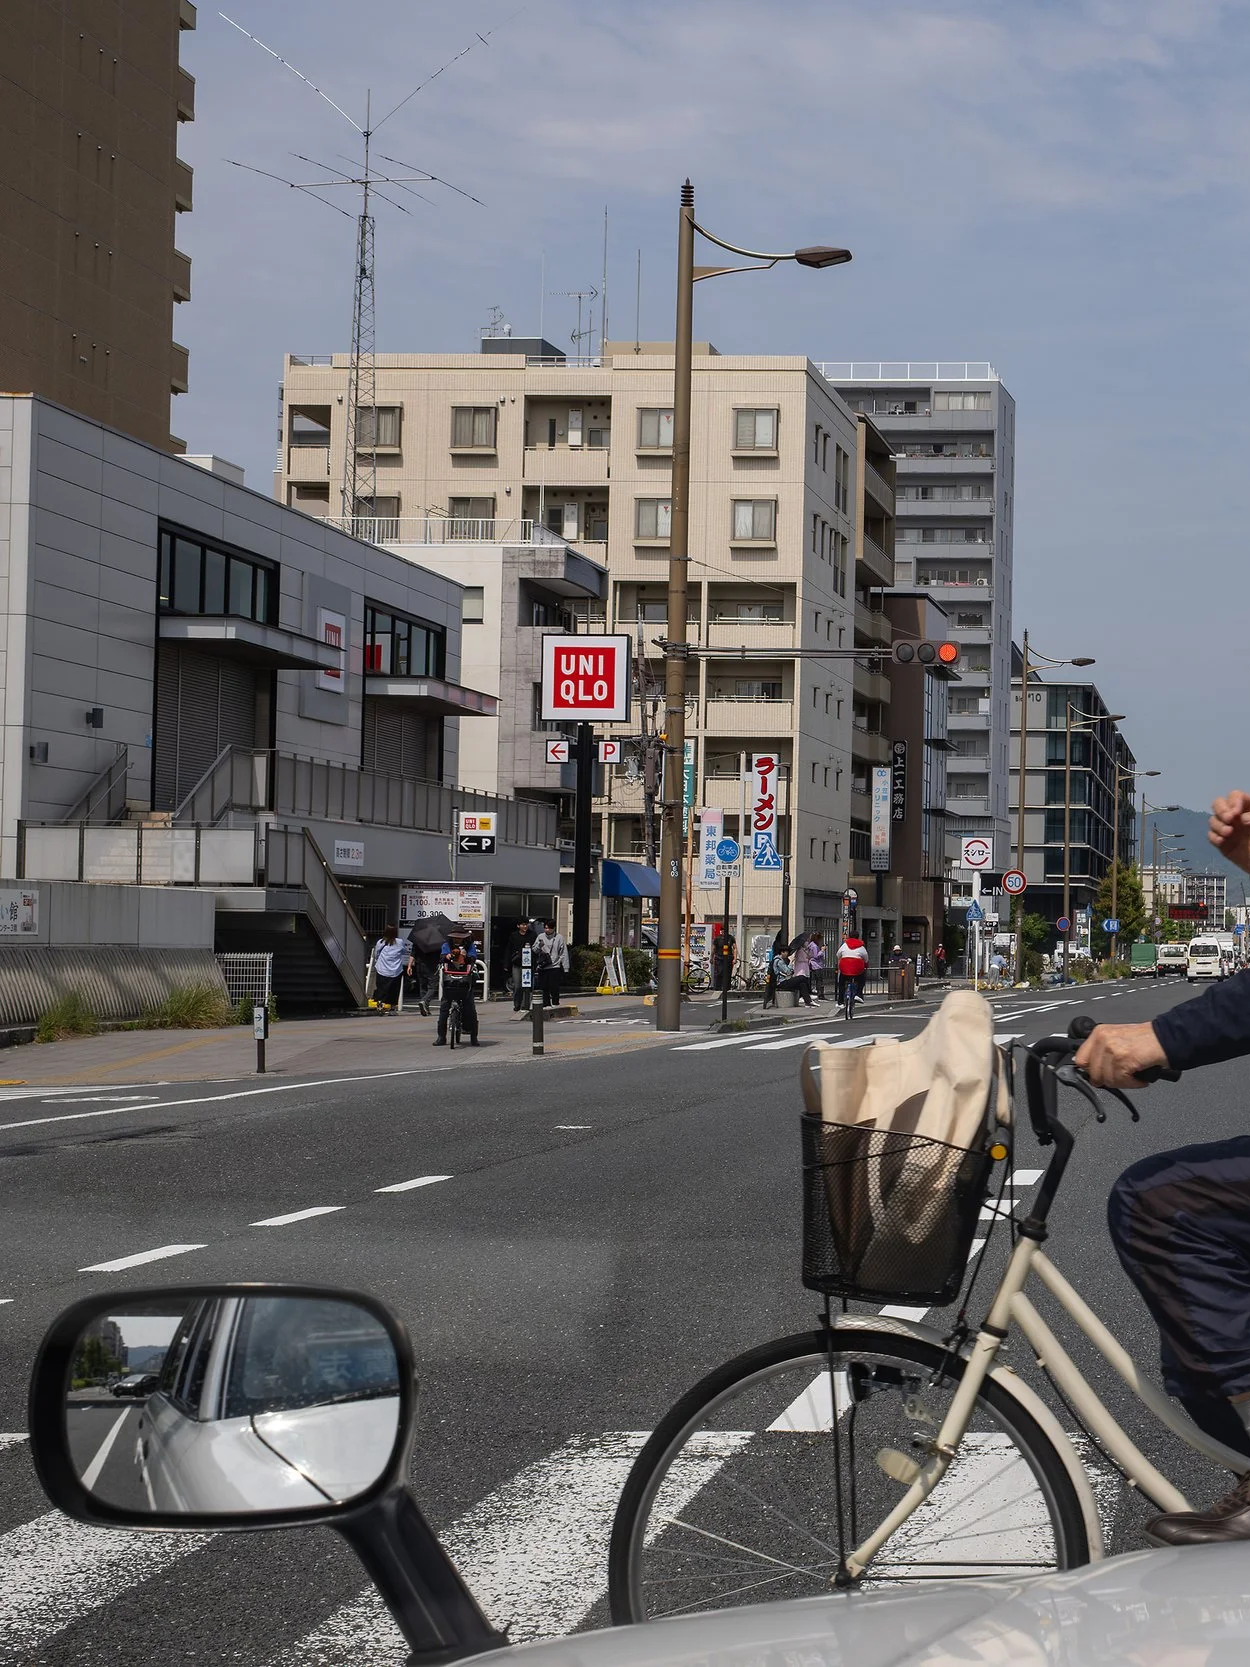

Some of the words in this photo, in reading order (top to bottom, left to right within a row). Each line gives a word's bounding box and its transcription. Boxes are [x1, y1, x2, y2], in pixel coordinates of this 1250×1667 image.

[561, 654, 605, 676] UNI
[560, 679, 608, 705] QLO
[603, 743, 616, 761] P
[753, 756, 775, 831] ラーメン
[481, 838, 492, 850] P
[704, 825, 717, 880] 東邦薬局
[963, 849, 991, 857] スシロー
[992, 886, 1003, 896] IN
[1007, 876, 1021, 888] 50
